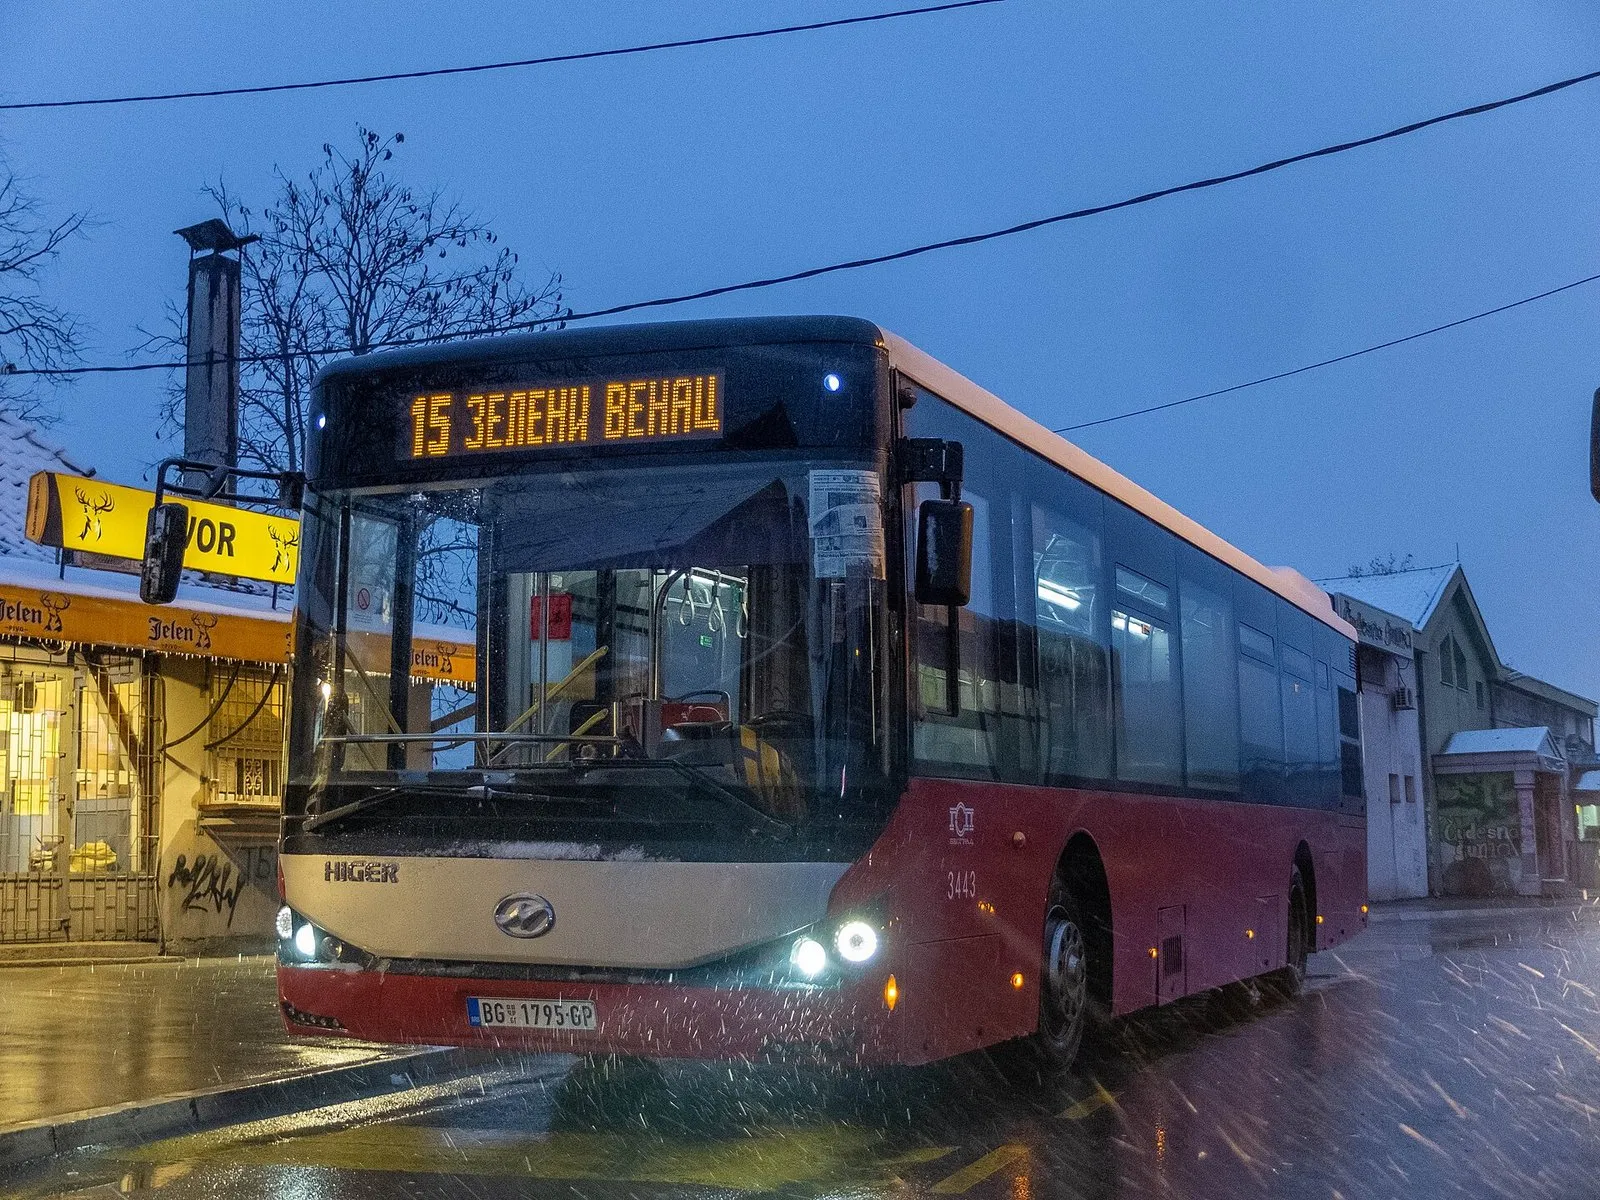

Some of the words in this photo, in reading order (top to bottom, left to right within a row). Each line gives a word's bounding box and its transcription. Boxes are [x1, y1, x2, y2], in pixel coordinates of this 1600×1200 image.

[411, 394, 452, 457] 15
[464, 386, 590, 450] ЗЕЛЕНИ
[604, 375, 721, 440] ВЕНАЦ
[185, 515, 237, 558] VOR
[148, 616, 194, 641] Jelen
[324, 860, 400, 884] HIGER
[947, 870, 976, 900] 3443
[482, 1002, 506, 1024] BG
